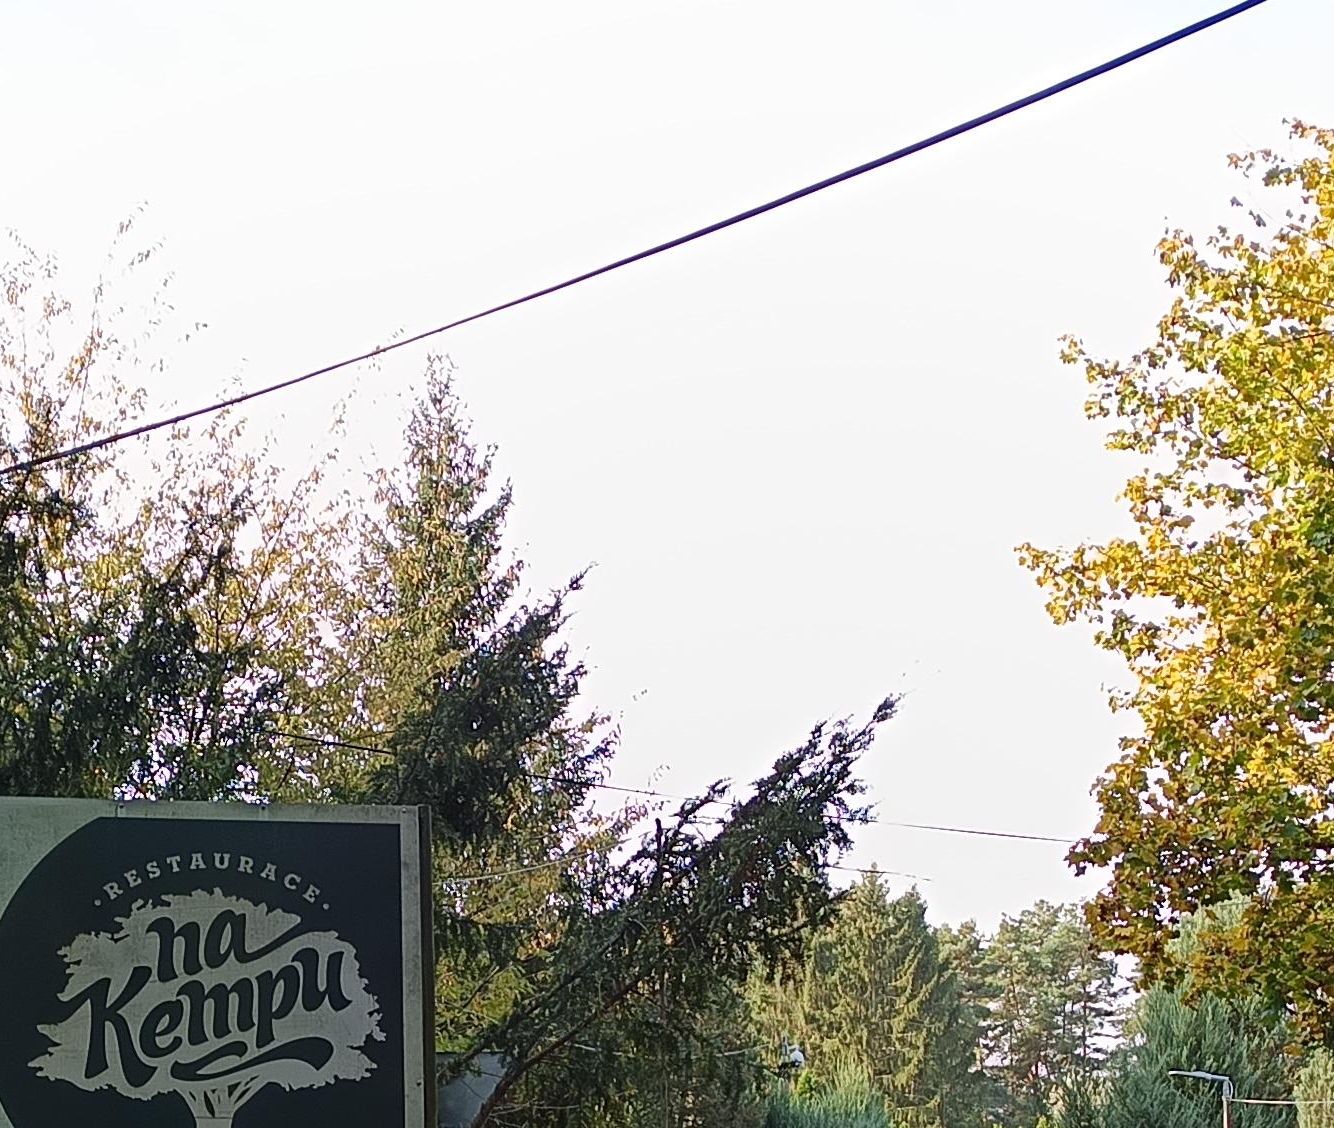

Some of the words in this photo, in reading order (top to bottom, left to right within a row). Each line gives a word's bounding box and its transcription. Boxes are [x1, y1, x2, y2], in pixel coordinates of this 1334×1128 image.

[103, 852, 321, 903] RESTAURACE
[146, 909, 302, 983] na
[56, 947, 353, 1088] Kempu
